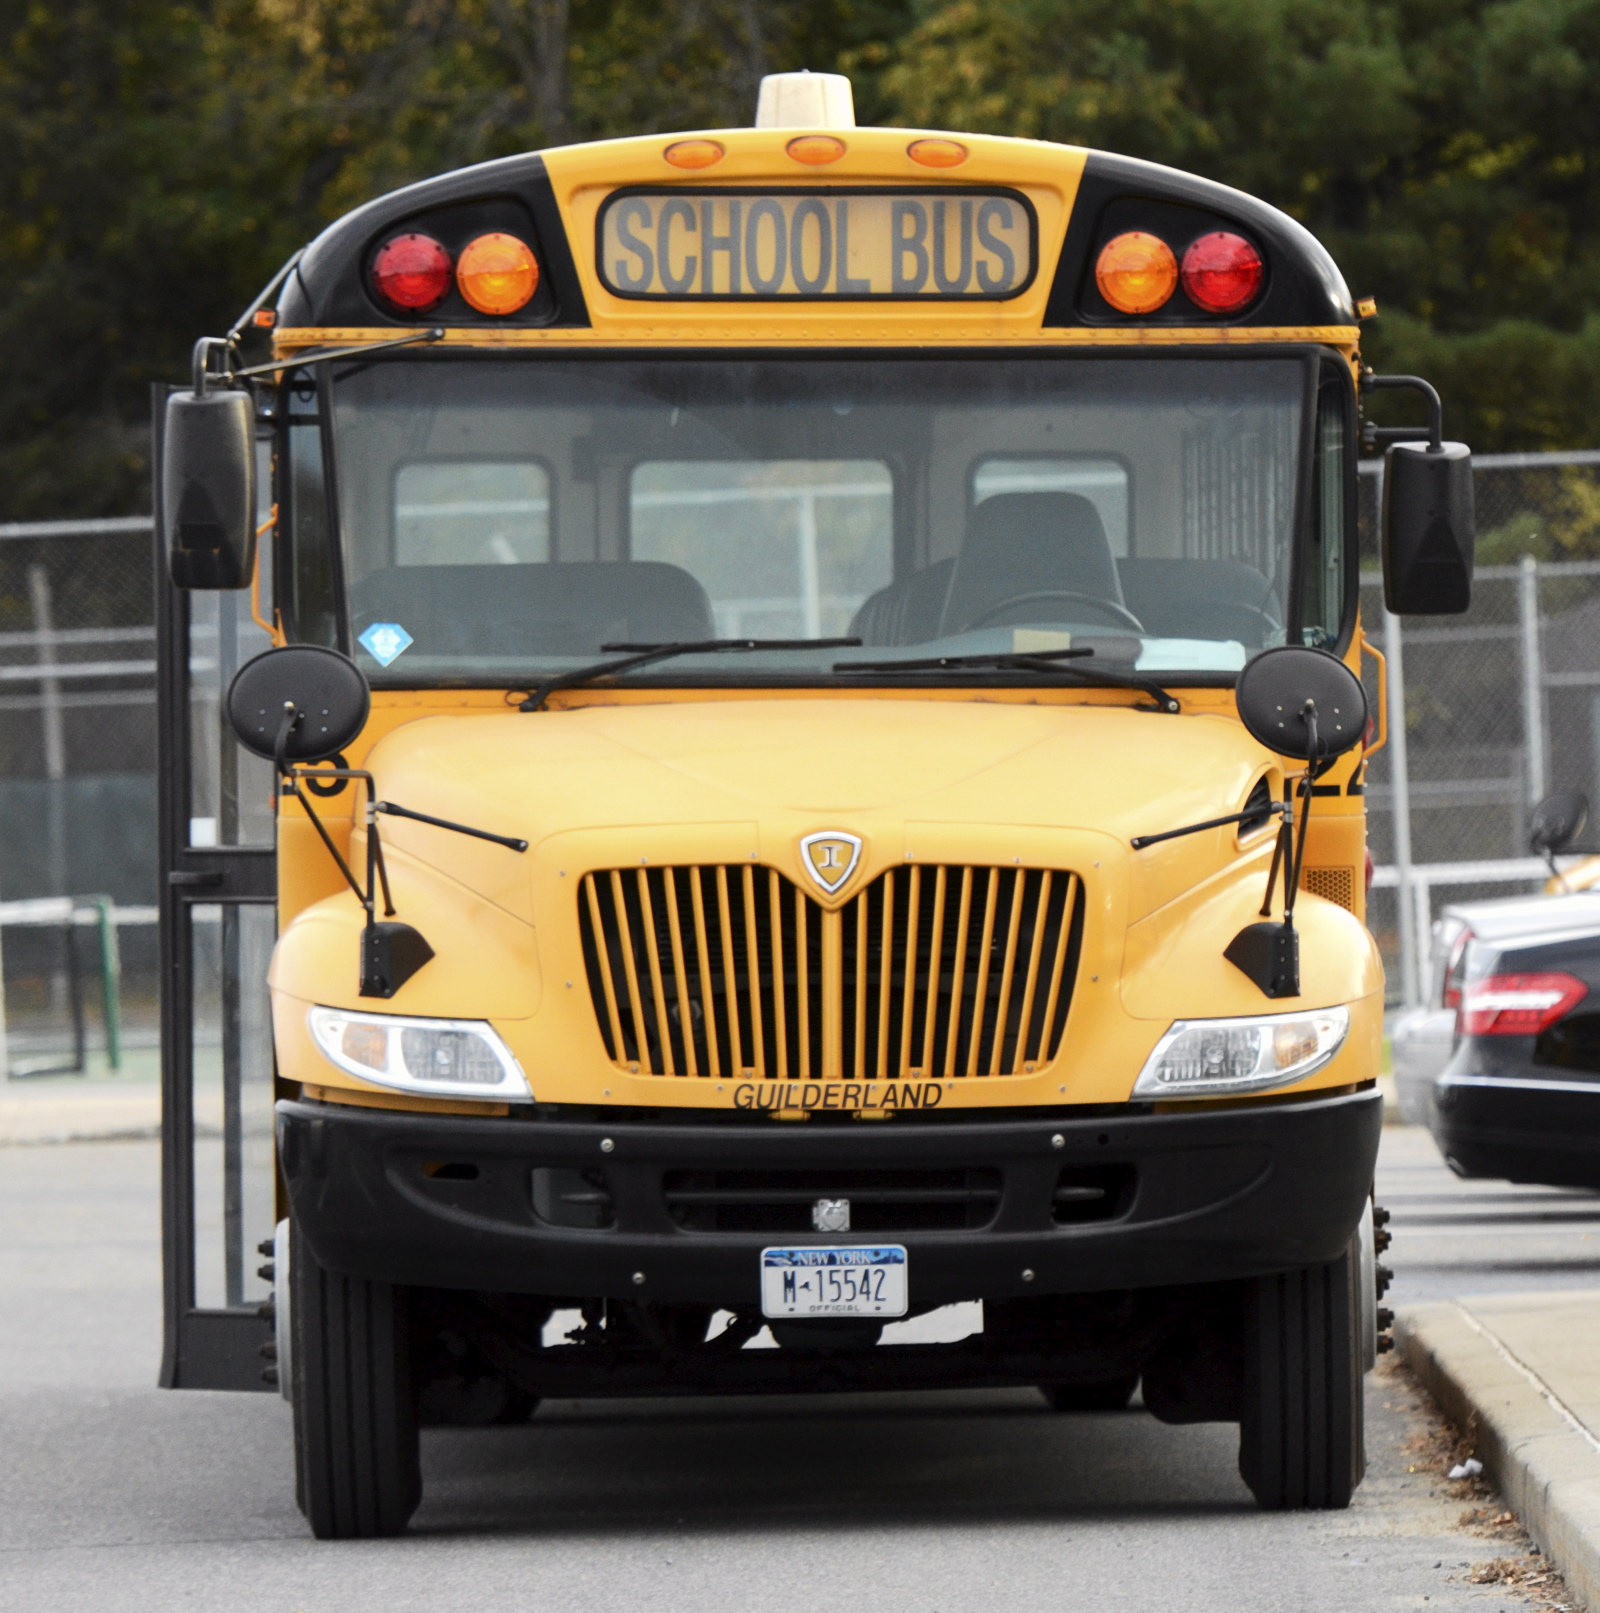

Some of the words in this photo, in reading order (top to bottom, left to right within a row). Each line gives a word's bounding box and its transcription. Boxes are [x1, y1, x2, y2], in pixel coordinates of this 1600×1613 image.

[615, 198, 871, 293] SCHOOL
[891, 199, 1016, 293] BUS
[733, 1083, 942, 1110] GUILDERLAND
[798, 1251, 830, 1265] NEW
[833, 1250, 871, 1264] YORK
